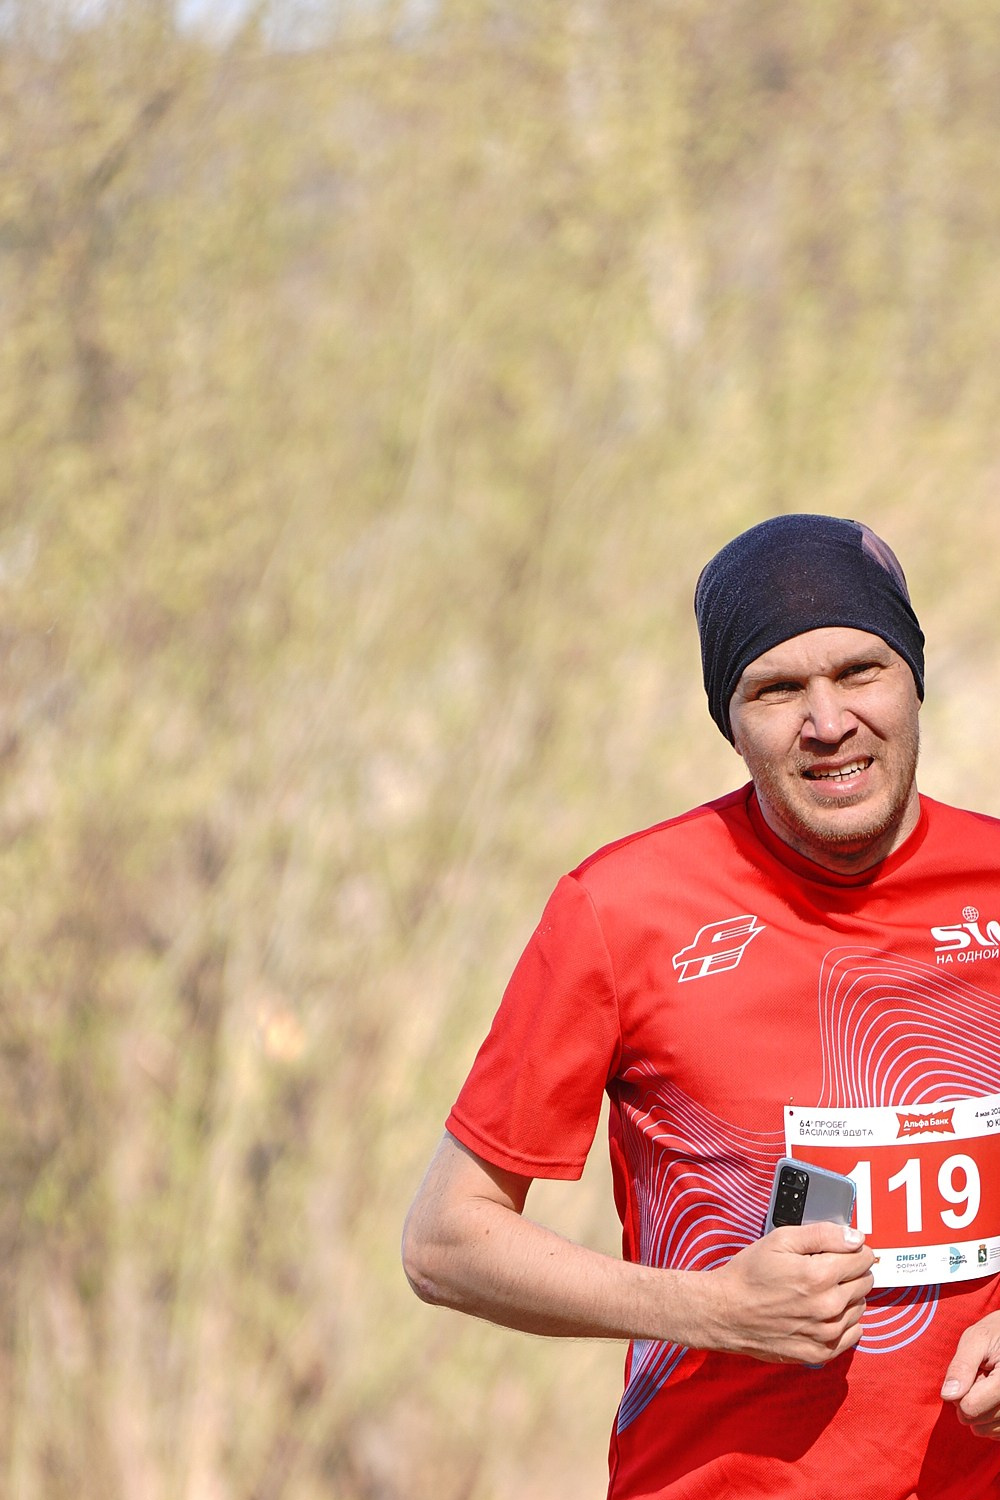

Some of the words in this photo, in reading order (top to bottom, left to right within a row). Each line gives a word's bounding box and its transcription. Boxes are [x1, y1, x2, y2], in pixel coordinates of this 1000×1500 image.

[936, 954, 954, 965] НА
[958, 949, 999, 963] ОДНОЙ
[904, 1119, 928, 1131] Альфа
[930, 1118, 949, 1126] Банк
[846, 1154, 981, 1234] 119
[896, 1253, 927, 1262] СИБУР
